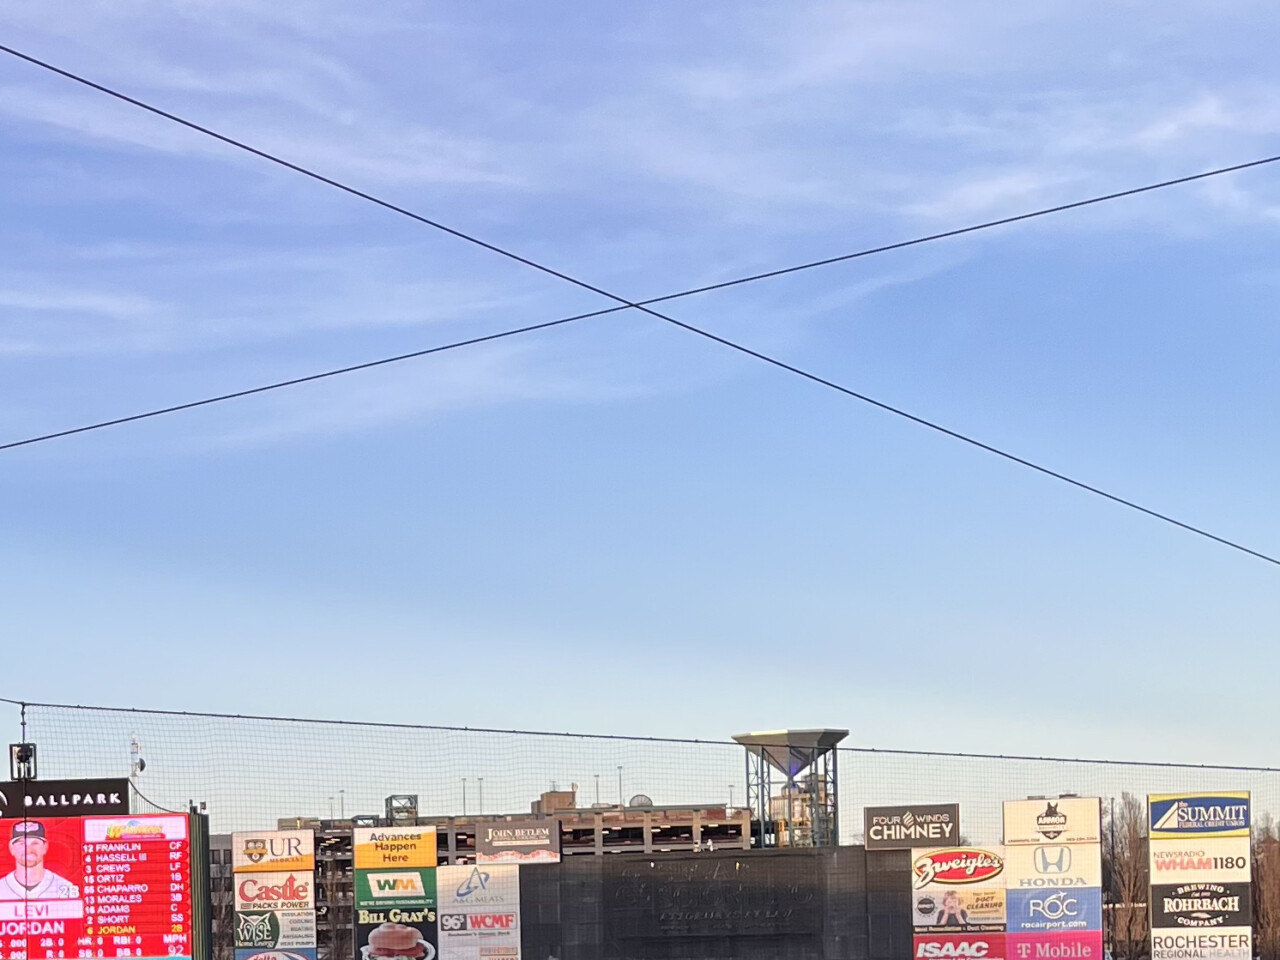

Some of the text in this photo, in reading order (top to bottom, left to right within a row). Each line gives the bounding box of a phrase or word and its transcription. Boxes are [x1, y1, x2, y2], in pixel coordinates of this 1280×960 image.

[24, 792, 121, 807] BALLPARK
[873, 813, 950, 825] FOUR WINDS
[1178, 805, 1247, 822] SUMMIT
[1204, 820, 1225, 828] CREDIT
[370, 832, 422, 843] Advances
[485, 828, 549, 842] JOHN BETLEM
[869, 823, 953, 840] CHIMNEY
[83, 841, 182, 853] 12 FRANKLIN CF
[269, 837, 303, 857] UR
[375, 842, 417, 852] Happen
[96, 853, 137, 862] HASSELL
[169, 852, 182, 860] RF
[382, 853, 409, 863] Here
[1153, 851, 1205, 859] NEWSRADIO
[85, 862, 181, 873] 3 CREWS LF
[1155, 857, 1246, 871] WHAM 1180
[97, 872, 182, 883] ORTIZ 1B
[914, 854, 1001, 889] Zweigle's
[97, 884, 148, 893] CHAPARRO
[170, 883, 184, 891] DH
[239, 873, 309, 903] Castle
[376, 878, 417, 892] WM
[1018, 877, 1087, 887] HONDA
[1177, 884, 1224, 894] BREWING
[97, 894, 142, 903] MORALES
[170, 893, 182, 902] 3B
[14, 904, 48, 917] LEVI
[97, 904, 178, 914] ADAMS C
[252, 901, 309, 910] PACKS POWER
[1030, 896, 1077, 919] ROC
[1163, 896, 1239, 913] ROHRBACH
[87, 913, 184, 925] 2 SHORT SS
[358, 908, 436, 924] BILL GRAY'S
[469, 914, 514, 928] WCMF
[1177, 916, 1223, 927] COMPANY
[87, 924, 183, 935] 6 JORDAN 2B
[1021, 920, 1086, 930] rocairport.com
[163, 934, 187, 943] MPH
[236, 928, 272, 941] WISE
[1153, 935, 1250, 949] ROCHESTER
[168, 945, 183, 957] 92
[916, 941, 989, 957] ISAAC
[1035, 942, 1092, 958] Mobile
[1153, 949, 1250, 959] REGIONAL HEALTH
